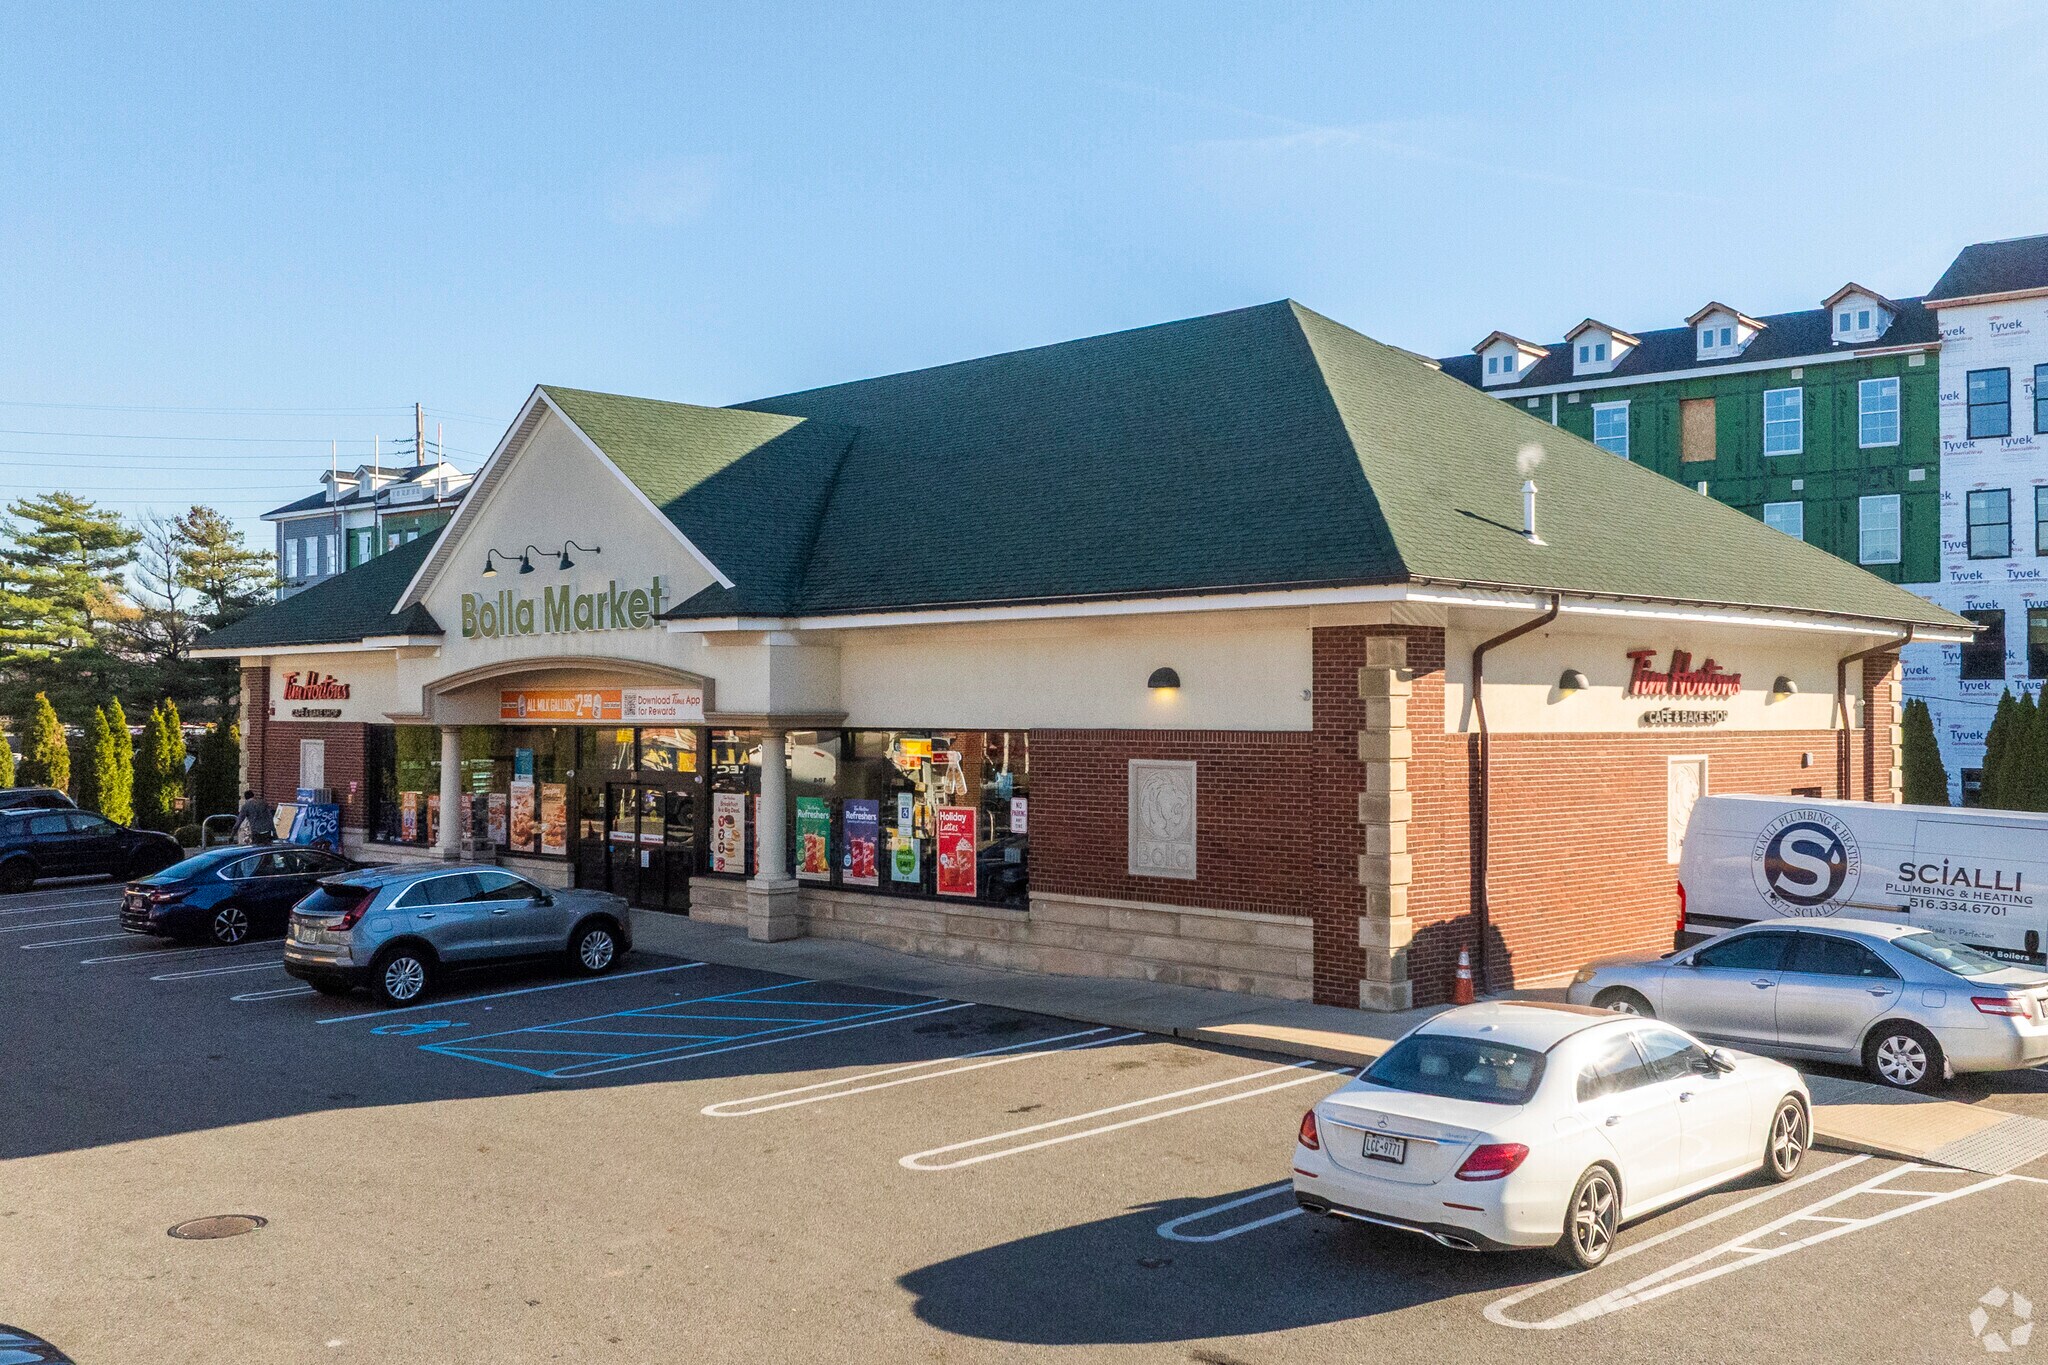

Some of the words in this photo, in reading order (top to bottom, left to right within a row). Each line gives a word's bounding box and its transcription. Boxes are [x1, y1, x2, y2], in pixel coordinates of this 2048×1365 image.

[1940, 326, 1966, 336] yvek
[1989, 319, 2022, 333] Tyvek
[1940, 391, 1960, 400] vek
[1943, 440, 1976, 452] Tyvek
[2000, 435, 2033, 448] Tyvek
[1942, 540, 1968, 551] Tyve
[1950, 570, 1983, 581] Tyvek
[2007, 568, 2040, 579] Tyvek
[461, 589, 536, 639] Bolla
[544, 576, 665, 634] Market
[1966, 600, 1998, 610] Tyvek
[2023, 599, 2048, 608] Tyve
[1942, 650, 1961, 662] Tyv
[1626, 650, 1668, 696] Tim
[1667, 650, 1742, 696] Hortons
[1902, 665, 1928, 676] yvek
[282, 671, 302, 700] Tim
[302, 671, 350, 700] Hortons
[1959, 680, 1990, 692] Tyvek
[527, 699, 536, 712] ALL
[638, 696, 670, 705] Download
[686, 695, 700, 706] App
[638, 706, 647, 716] for
[648, 706, 676, 716] Rewards
[1674, 711, 1680, 723] &
[1682, 710, 1705, 723] BAKE
[1706, 710, 1728, 723] SHOP
[1950, 730, 1983, 741] Tyvek
[308, 806, 322, 817] We
[798, 809, 829, 819] Refreshers
[846, 811, 876, 820] Refreshers
[940, 811, 966, 824] Holiday
[310, 819, 337, 840] Ice
[940, 821, 958, 831] Lattes
[1754, 824, 1778, 862] SCIALLI
[1778, 810, 1833, 827] PLUMBING
[1832, 822, 1840, 832] &
[1838, 829, 1859, 876] HEATING
[1774, 828, 1836, 897] S
[1885, 883, 1954, 897] PLUMBING
[1974, 892, 2033, 904] HEATING
[1910, 898, 2007, 916] 516.334.6701
[1928, 925, 1945, 934] Trade
[1997, 951, 2030, 961] Boilers
